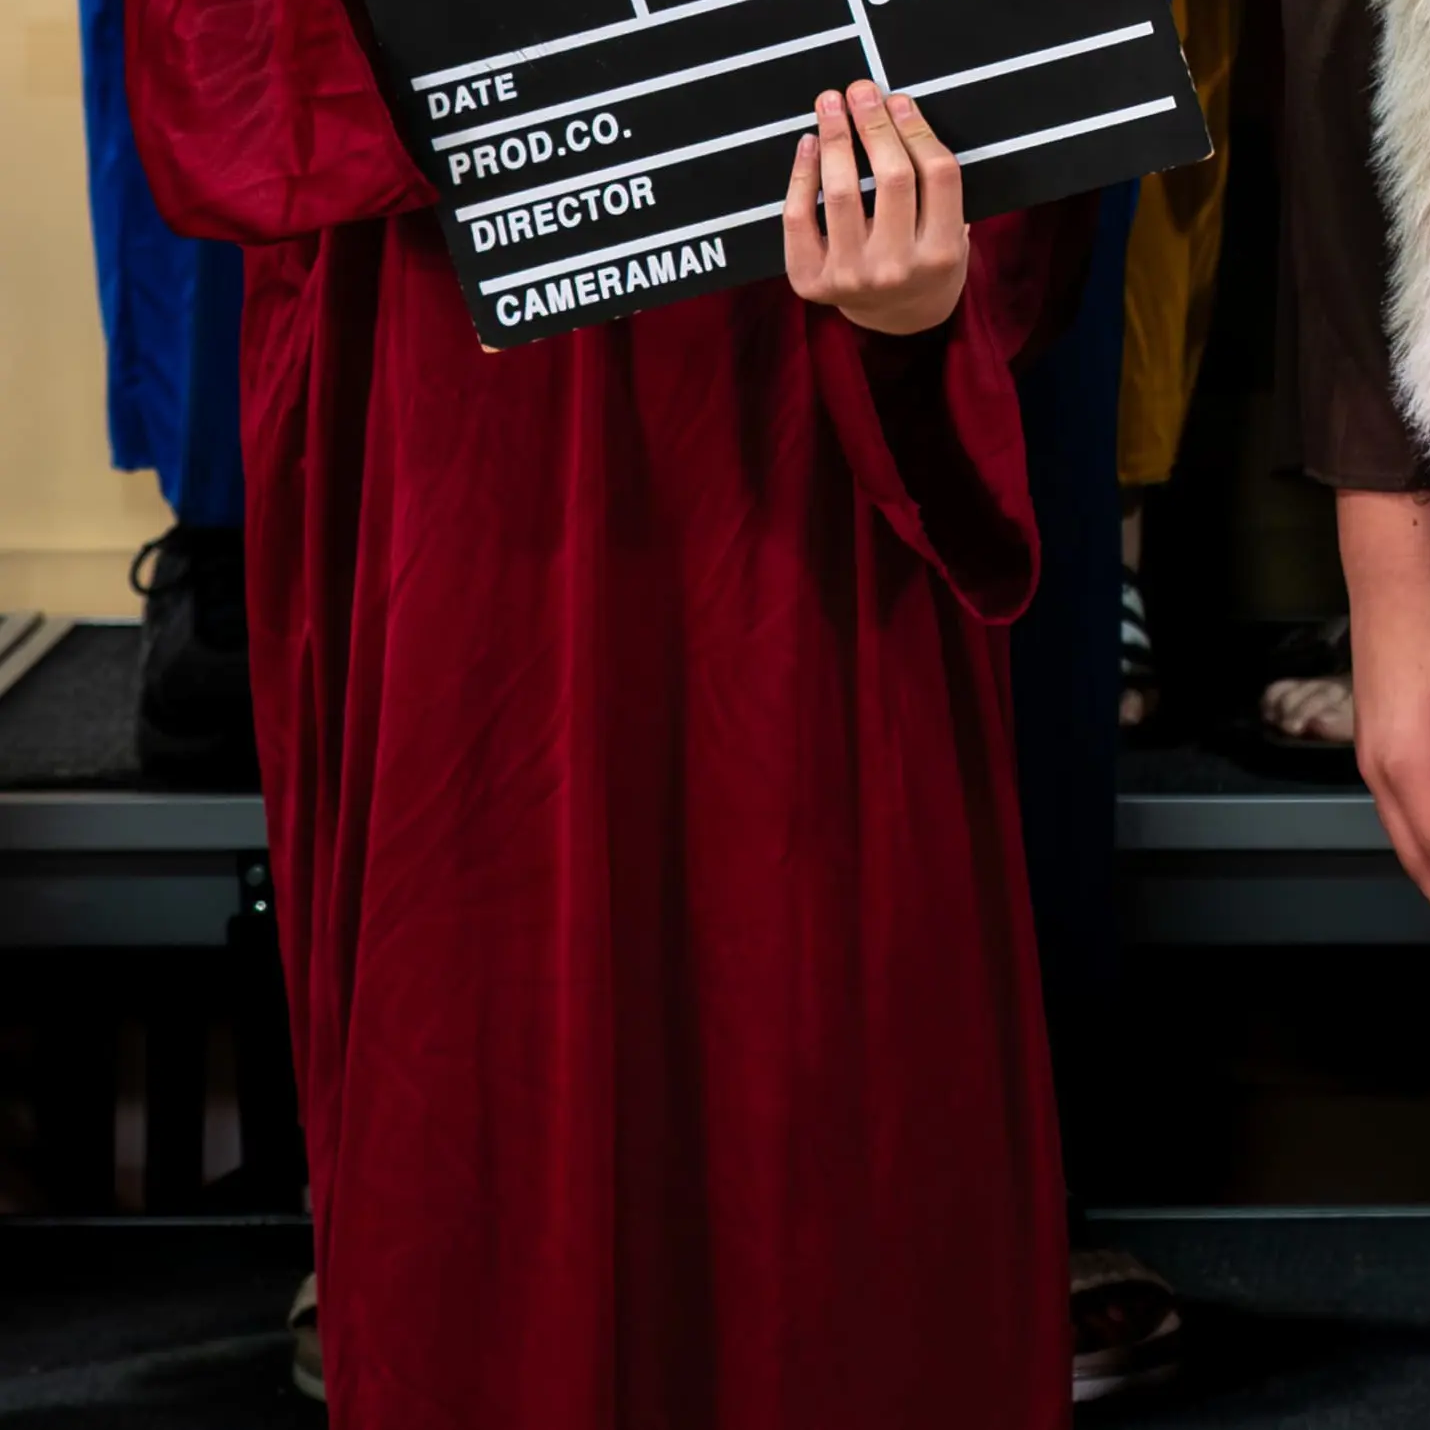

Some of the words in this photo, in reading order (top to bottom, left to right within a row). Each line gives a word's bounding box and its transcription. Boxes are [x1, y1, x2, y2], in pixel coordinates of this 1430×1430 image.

[428, 72, 518, 120] DATE
[448, 112, 633, 185] PROD.CO.
[470, 176, 656, 253] DIRECTOR
[496, 237, 727, 327] CAMERAMAN
